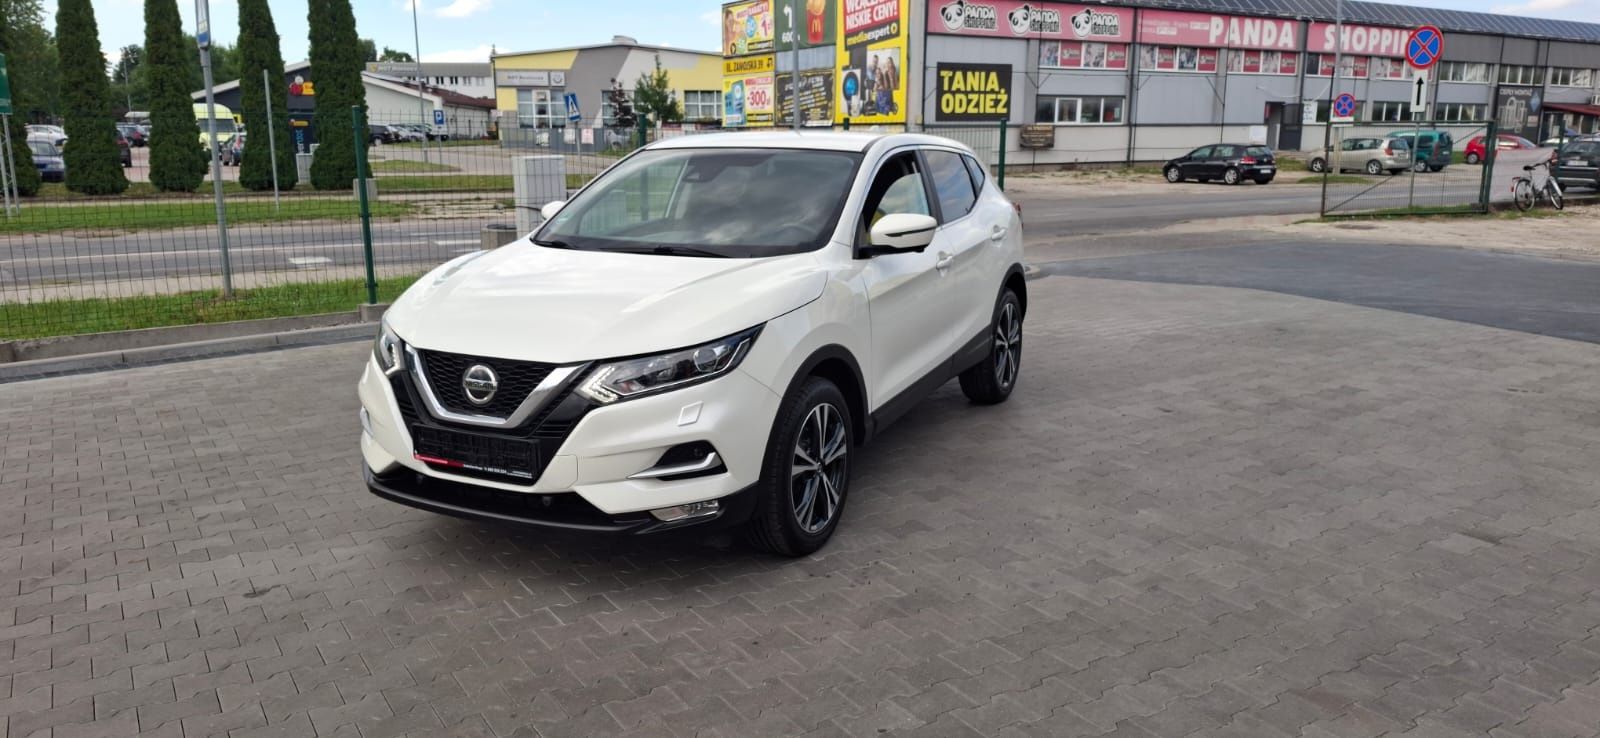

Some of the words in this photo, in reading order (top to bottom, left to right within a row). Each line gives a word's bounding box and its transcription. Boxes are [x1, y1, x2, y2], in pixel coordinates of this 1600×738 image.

[846, 8, 872, 30] NISKIE
[873, 1, 899, 22] CENY!
[965, 6, 996, 18] PANDA
[1030, 9, 1060, 22] PANDA
[1091, 13, 1118, 26] PANDA
[964, 17, 996, 29] SHOPPING
[846, 25, 890, 46] mediaexpert
[1209, 16, 1294, 48] PANDA
[1324, 24, 1409, 55] SHOPPIN
[940, 70, 1000, 91] TANIA
[941, 88, 1008, 114] ODZIEŻ
